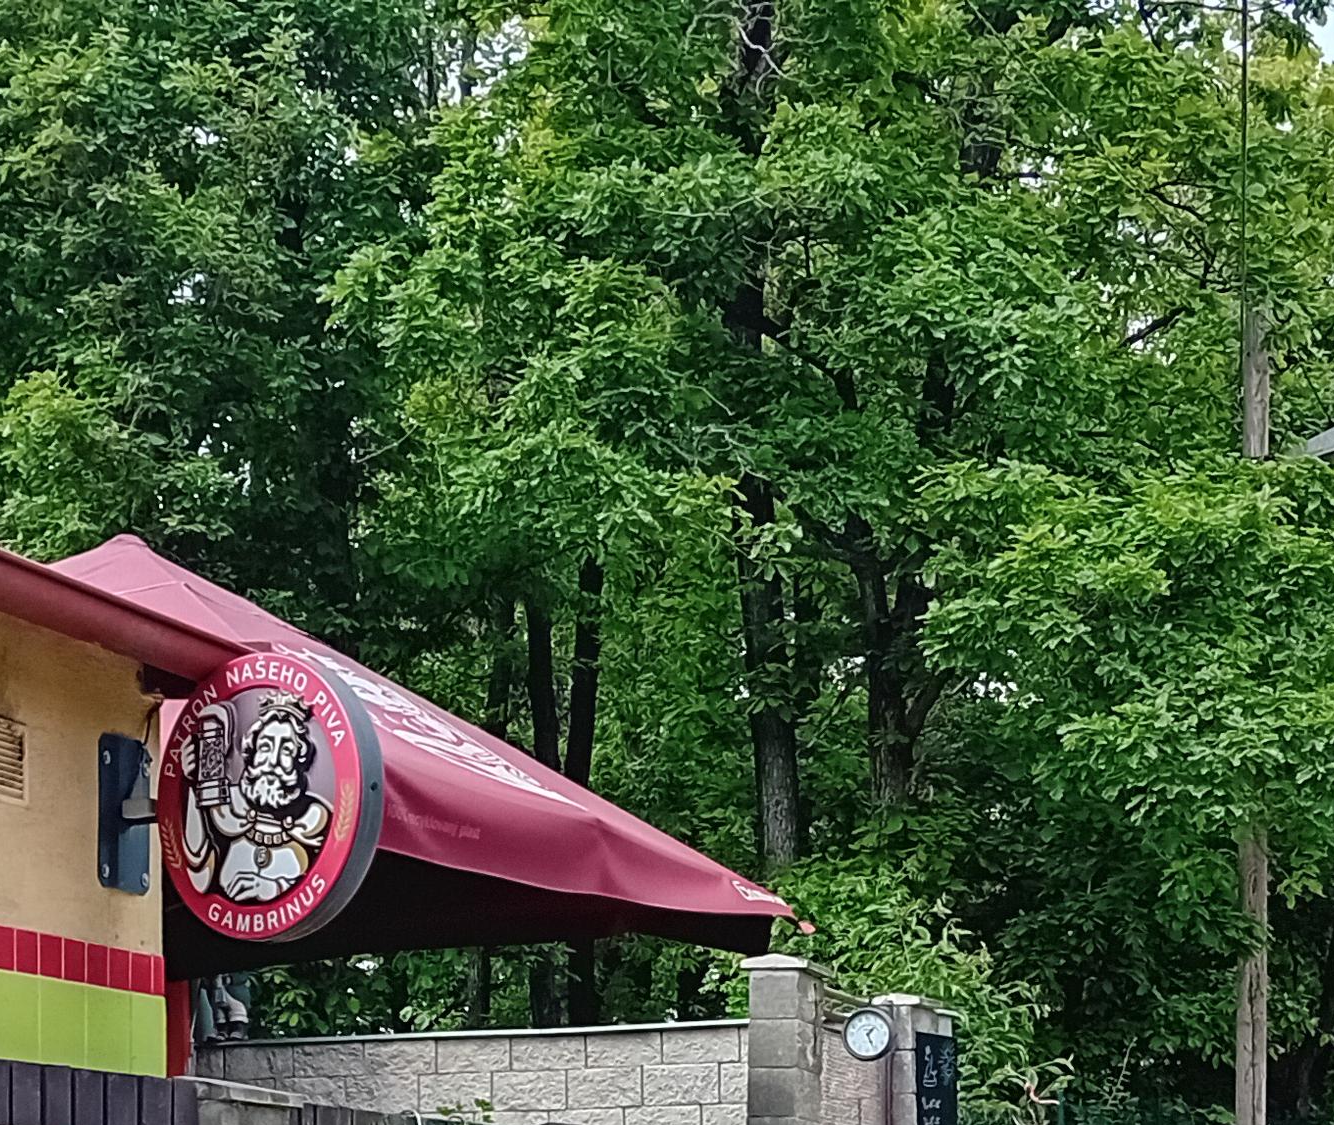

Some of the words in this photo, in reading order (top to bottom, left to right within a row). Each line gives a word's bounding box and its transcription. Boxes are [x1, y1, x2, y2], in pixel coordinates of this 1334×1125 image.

[164, 684, 218, 778] PATRON
[226, 655, 308, 692] NAŠEHO
[313, 690, 348, 748] PIVA
[207, 874, 327, 934] GAMBRINUS
